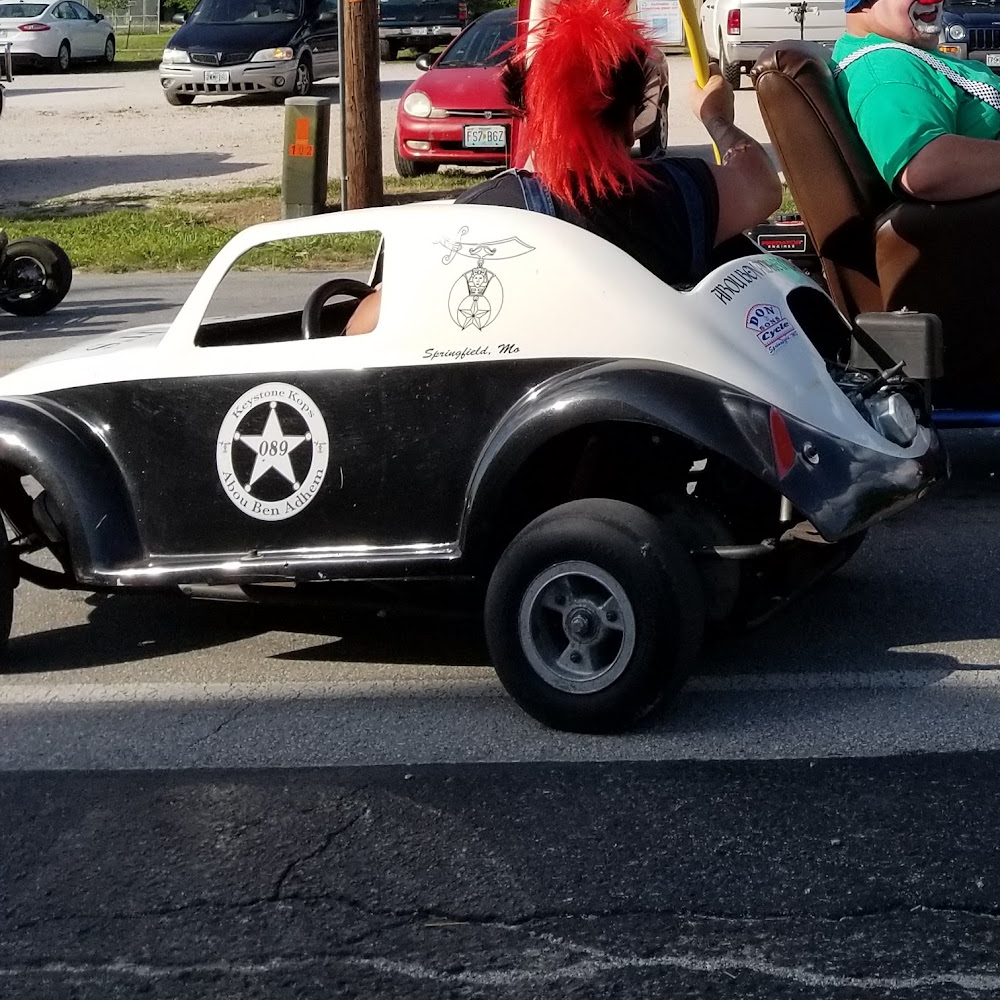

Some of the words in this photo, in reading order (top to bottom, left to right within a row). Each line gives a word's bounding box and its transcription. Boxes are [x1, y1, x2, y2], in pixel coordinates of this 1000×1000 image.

[749, 305, 775, 328] DON
[759, 316, 781, 330] SONS
[761, 321, 790, 342] Cycle
[422, 345, 492, 360] Springfield,
[497, 343, 520, 354] Mo
[231, 390, 285, 419] Keystone
[288, 390, 315, 418] Kops
[259, 440, 289, 456] 089
[222, 471, 249, 507] Abou
[251, 501, 280, 516] Ben
[284, 468, 324, 514] Adhem
